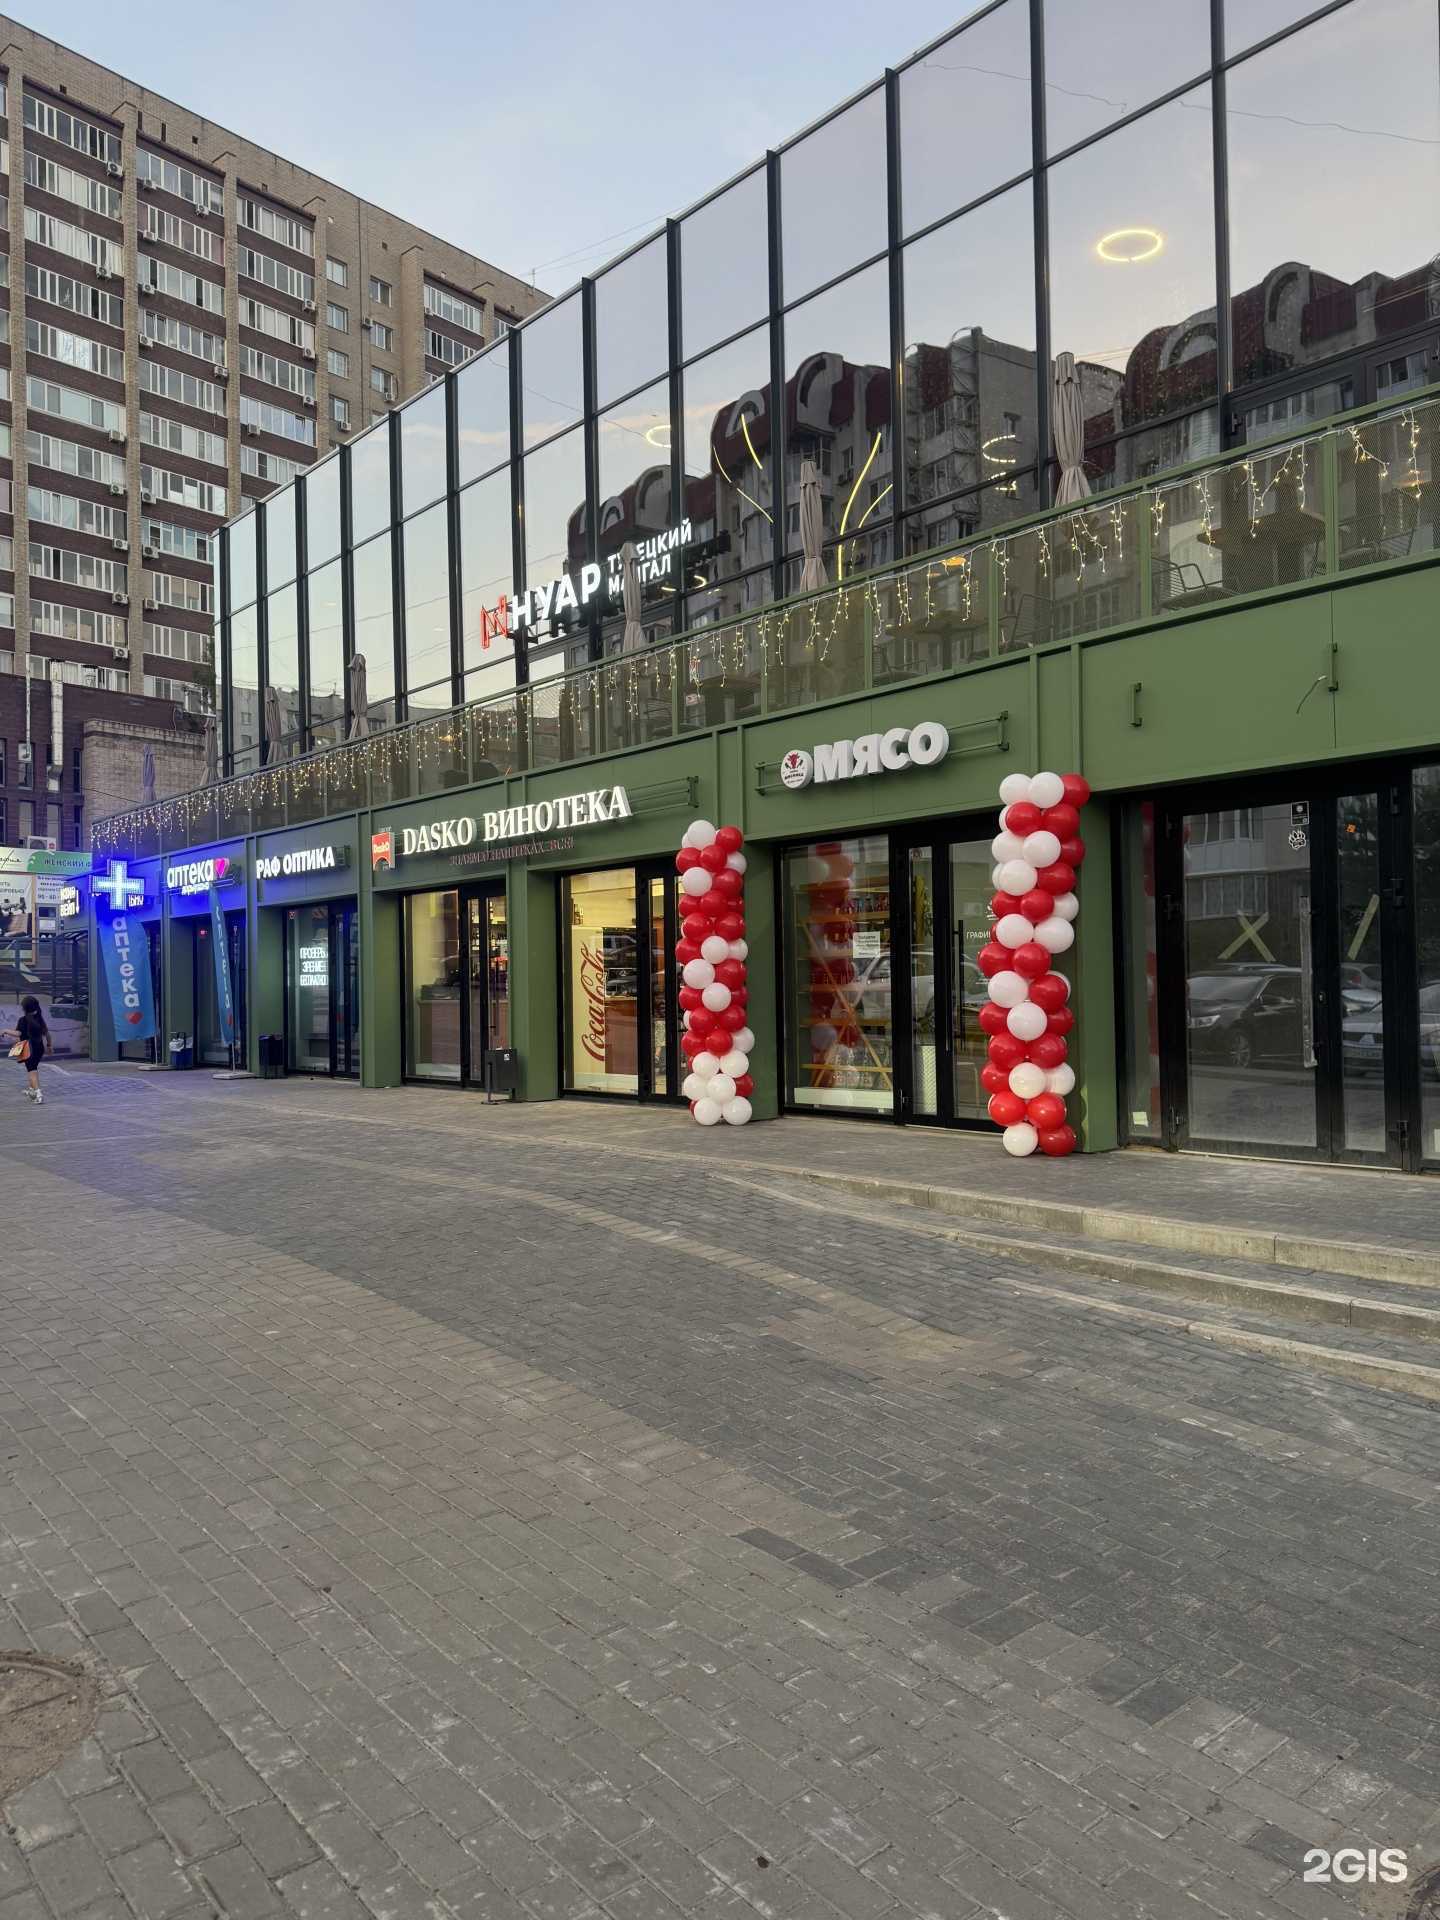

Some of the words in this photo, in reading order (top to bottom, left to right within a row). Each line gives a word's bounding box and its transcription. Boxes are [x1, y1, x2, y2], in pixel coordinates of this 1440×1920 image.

[608, 518, 692, 574] ТЕЦКИЙ
[512, 562, 601, 631] НУАР
[813, 721, 950, 784] МЯСО
[402, 817, 474, 856] DASKO
[483, 786, 634, 842] ВИНОТЕКА
[166, 859, 215, 888] аптека
[255, 858, 281, 879] РАФ
[282, 846, 336, 873] ОПТИКА
[112, 916, 141, 1009] аптека
